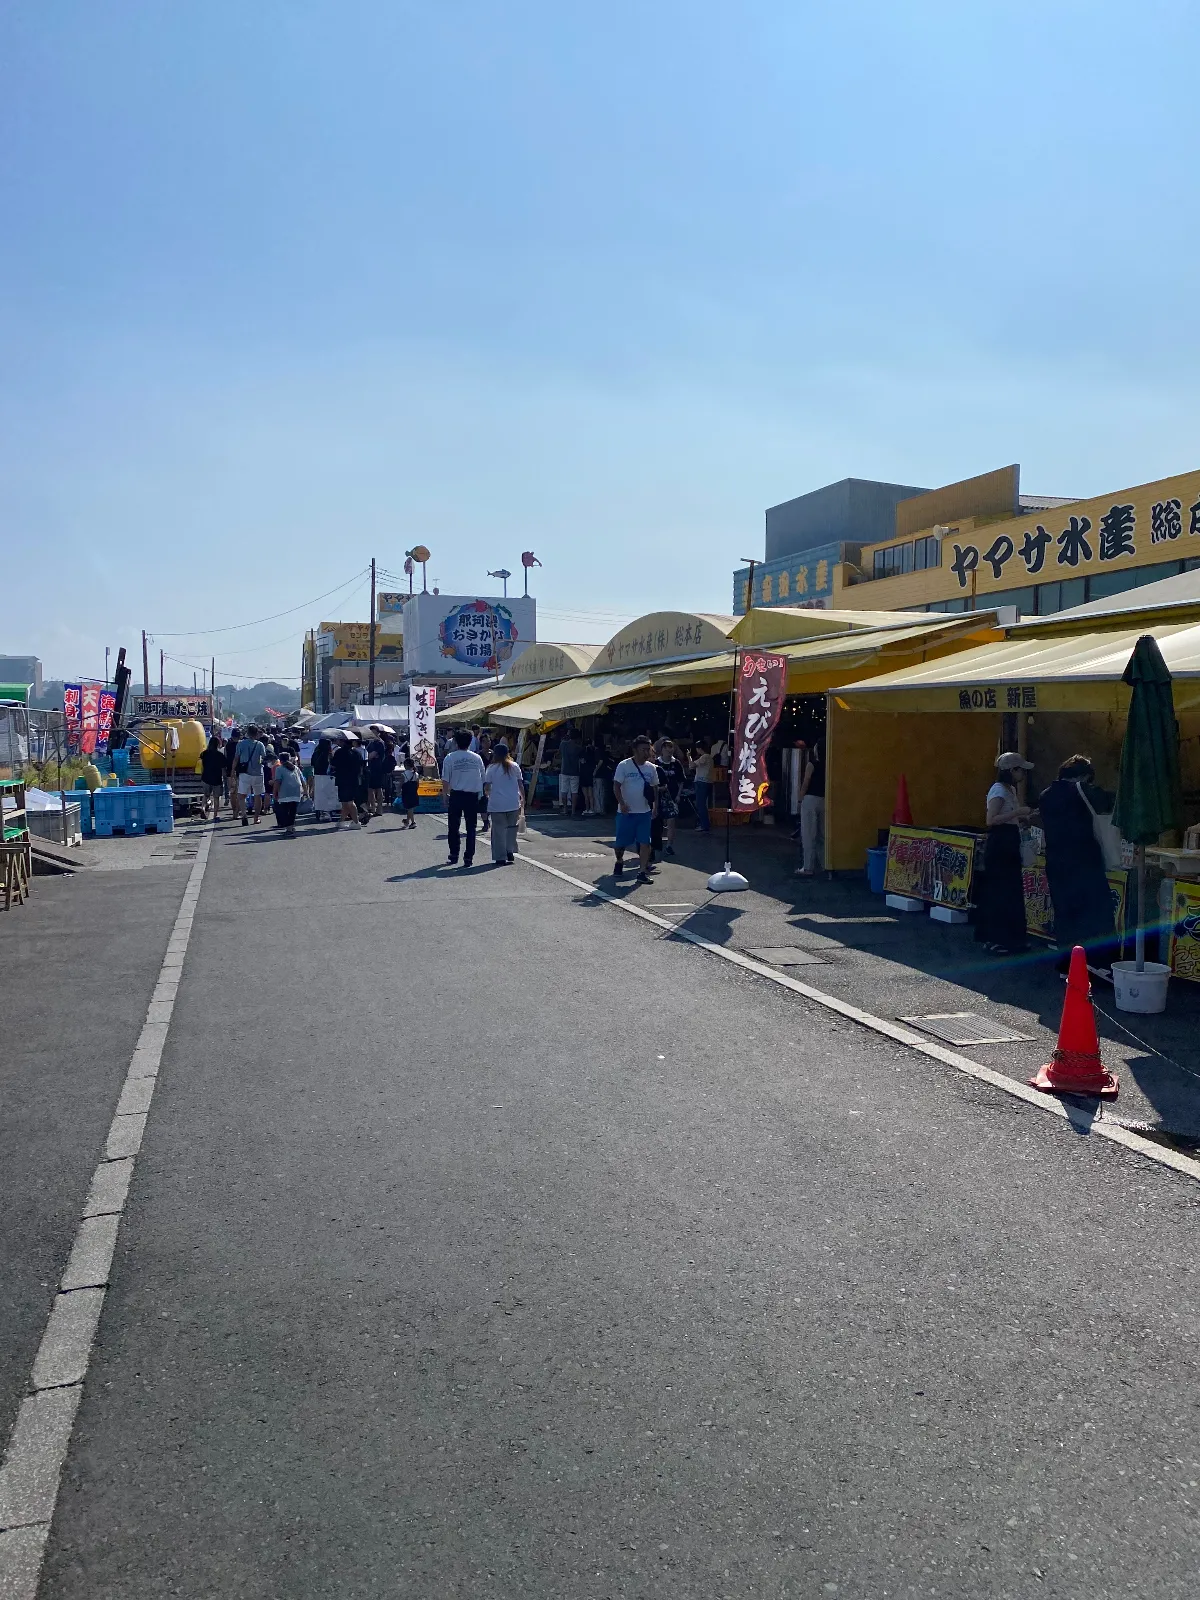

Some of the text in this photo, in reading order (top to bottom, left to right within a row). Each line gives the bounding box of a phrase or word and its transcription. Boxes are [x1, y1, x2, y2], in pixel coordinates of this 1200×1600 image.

[950, 504, 1137, 588] ヤマサ水産
[453, 628, 504, 641] おさかな
[675, 620, 702, 647] 総本店
[466, 643, 492, 656] 市場
[83, 690, 98, 728] 天丼
[959, 687, 1036, 709] 魚の店 新屋
[738, 677, 774, 804] えび焼き
